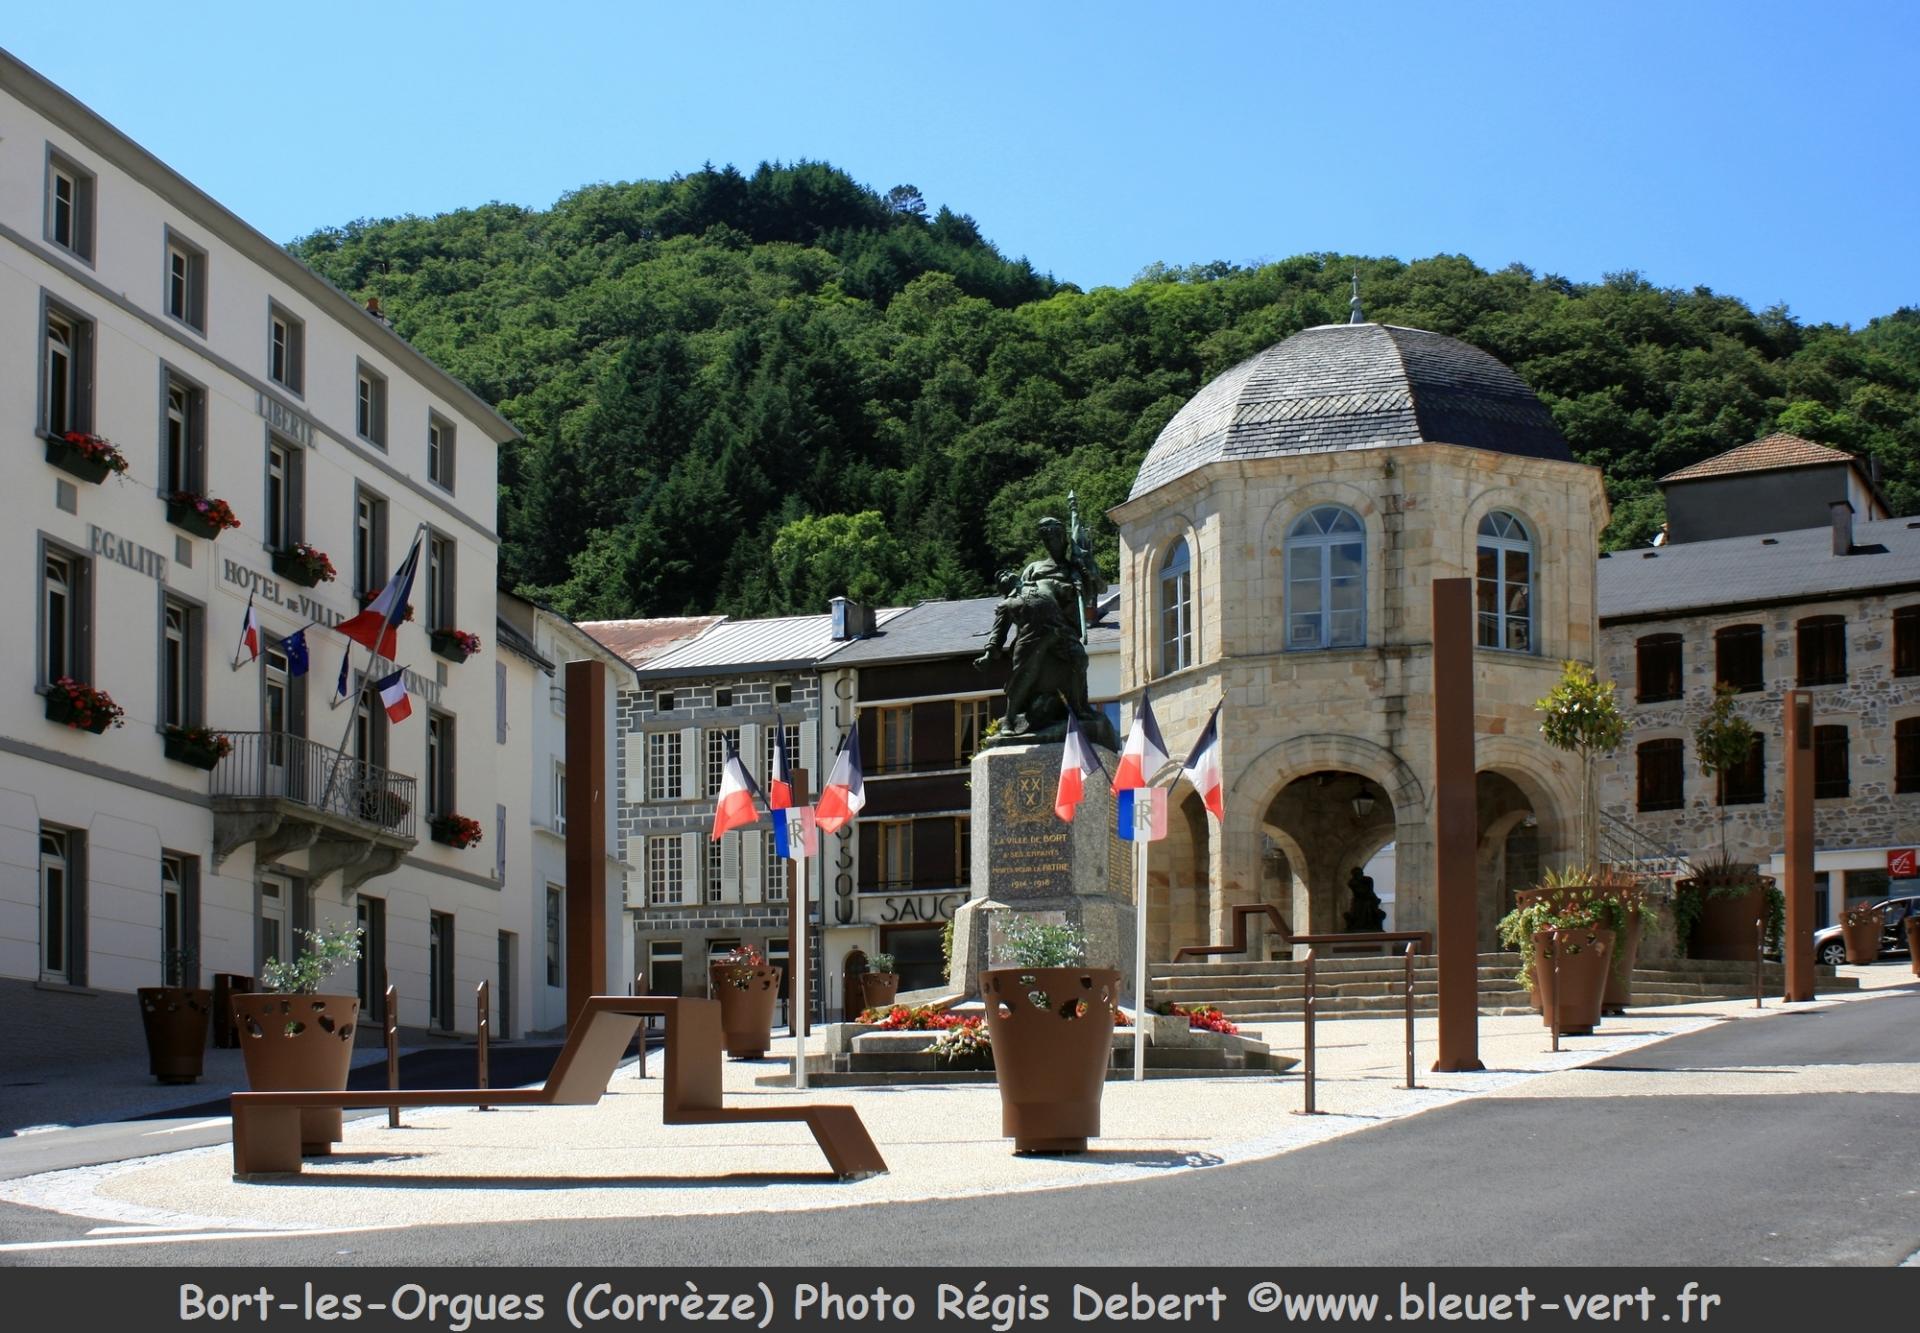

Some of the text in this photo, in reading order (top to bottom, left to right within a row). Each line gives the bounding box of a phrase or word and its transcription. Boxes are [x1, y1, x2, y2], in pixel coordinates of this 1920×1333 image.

[254, 391, 316, 449] LIBERTE
[87, 522, 167, 583] EGALITE
[224, 558, 284, 606] HOTEL
[1043, 833, 1068, 843] BORT
